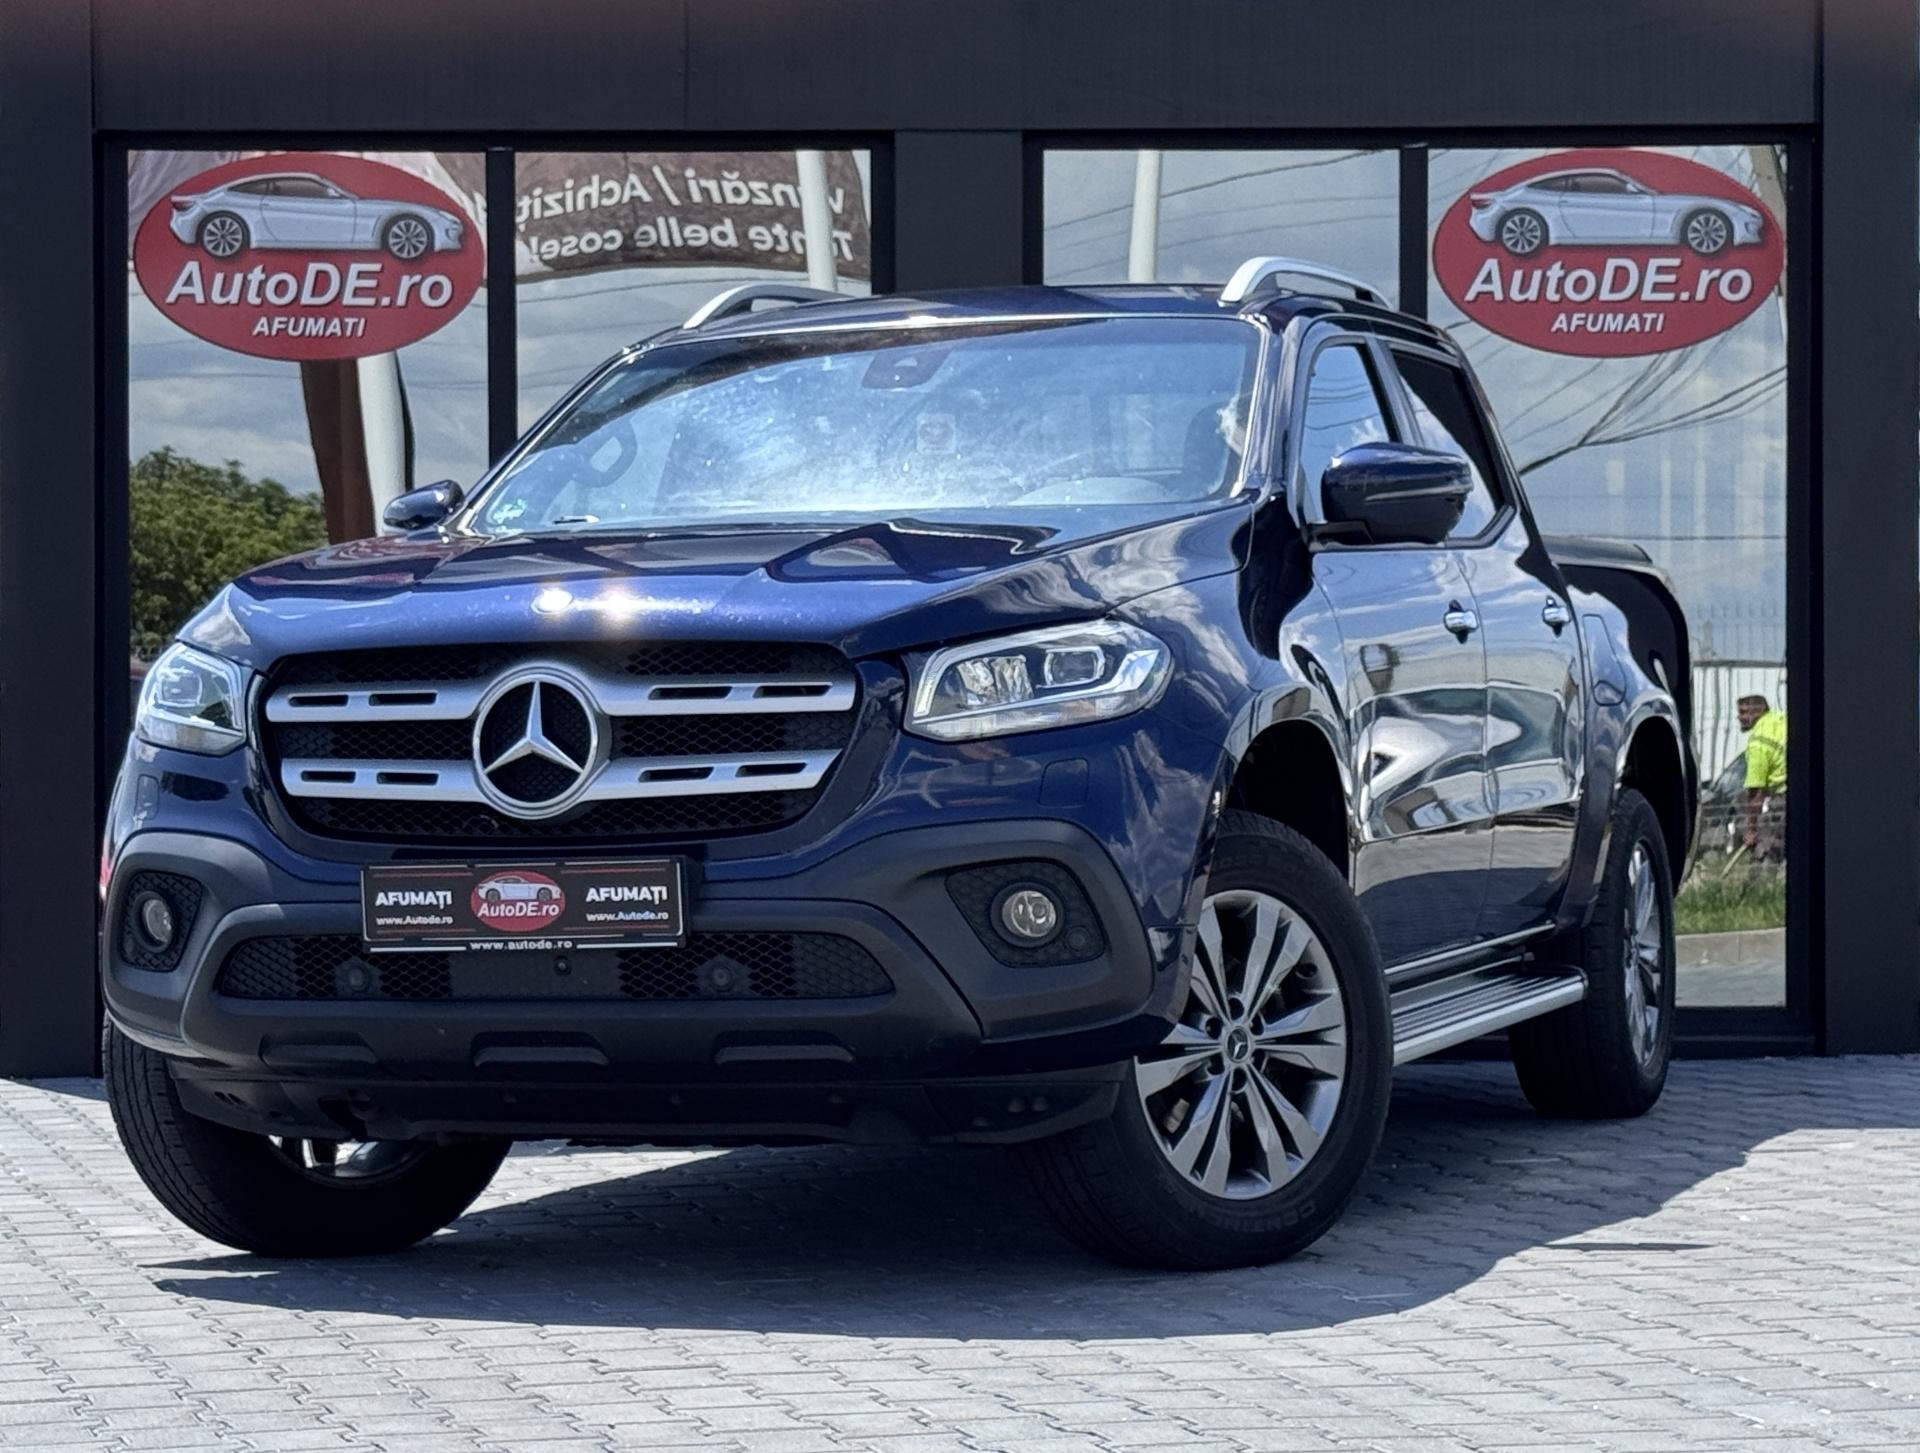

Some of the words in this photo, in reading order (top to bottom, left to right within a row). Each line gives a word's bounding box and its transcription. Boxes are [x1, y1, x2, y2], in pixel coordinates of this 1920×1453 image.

[165, 260, 454, 309] AutoDE.ro
[1464, 257, 1753, 304] AutoDE.ro
[252, 316, 366, 338] AFUMATI
[1550, 312, 1665, 333] AFUMATI
[477, 901, 560, 918] AutoDE.ro
[585, 910, 669, 922] www.Autode.ro
[376, 915, 453, 926] www.Autode.ro
[469, 939, 573, 951] www.autode.ro
